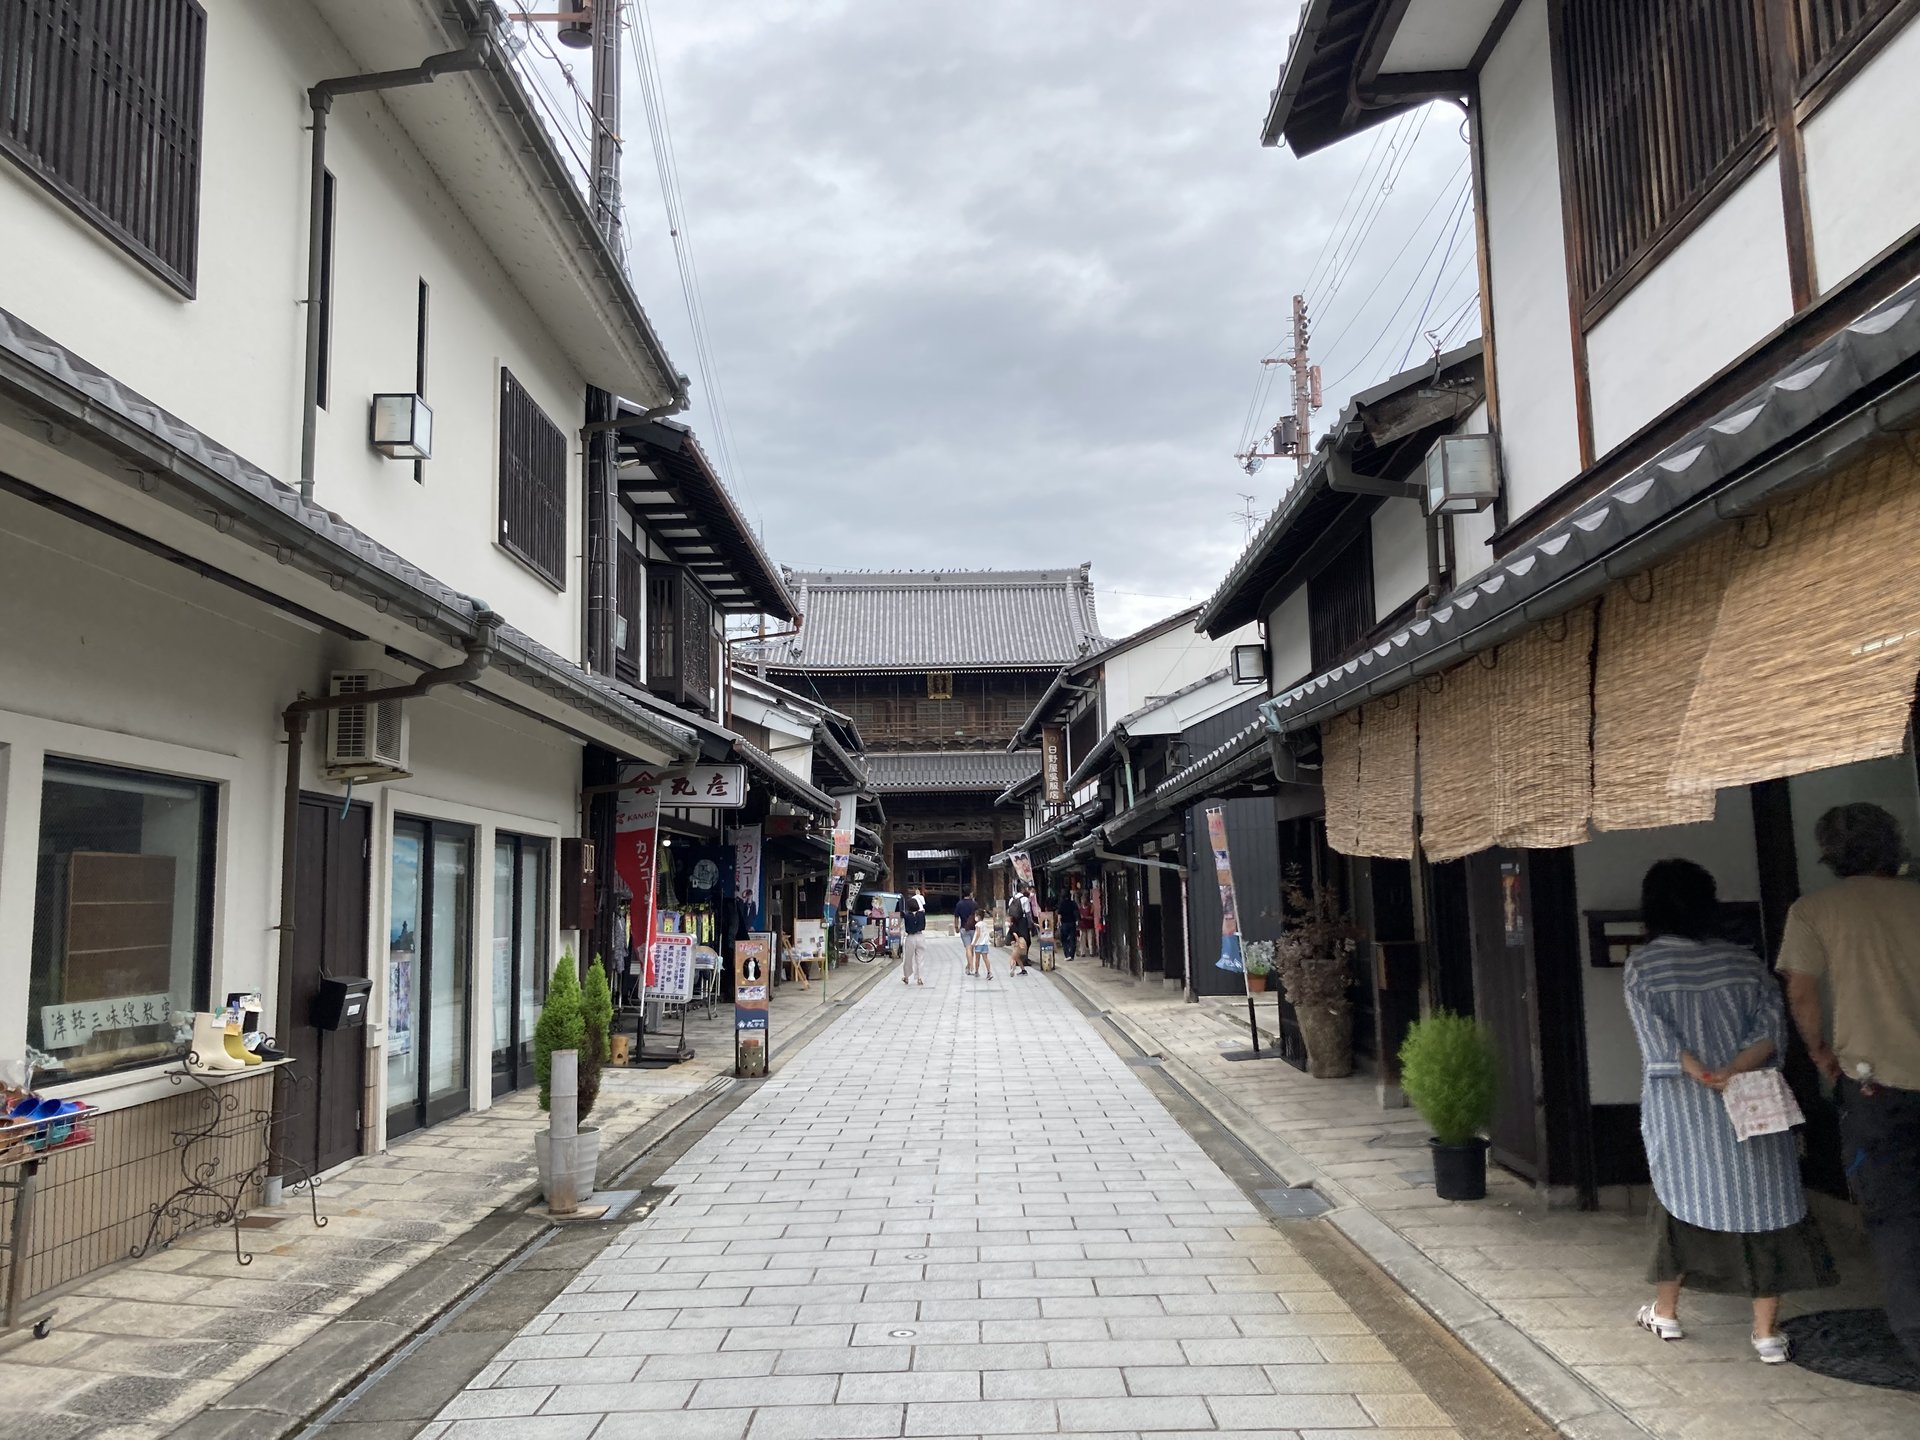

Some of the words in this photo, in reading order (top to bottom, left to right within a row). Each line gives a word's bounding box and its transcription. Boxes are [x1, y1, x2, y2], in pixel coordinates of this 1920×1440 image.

[51, 996, 170, 1041] 津軽三味線教室
